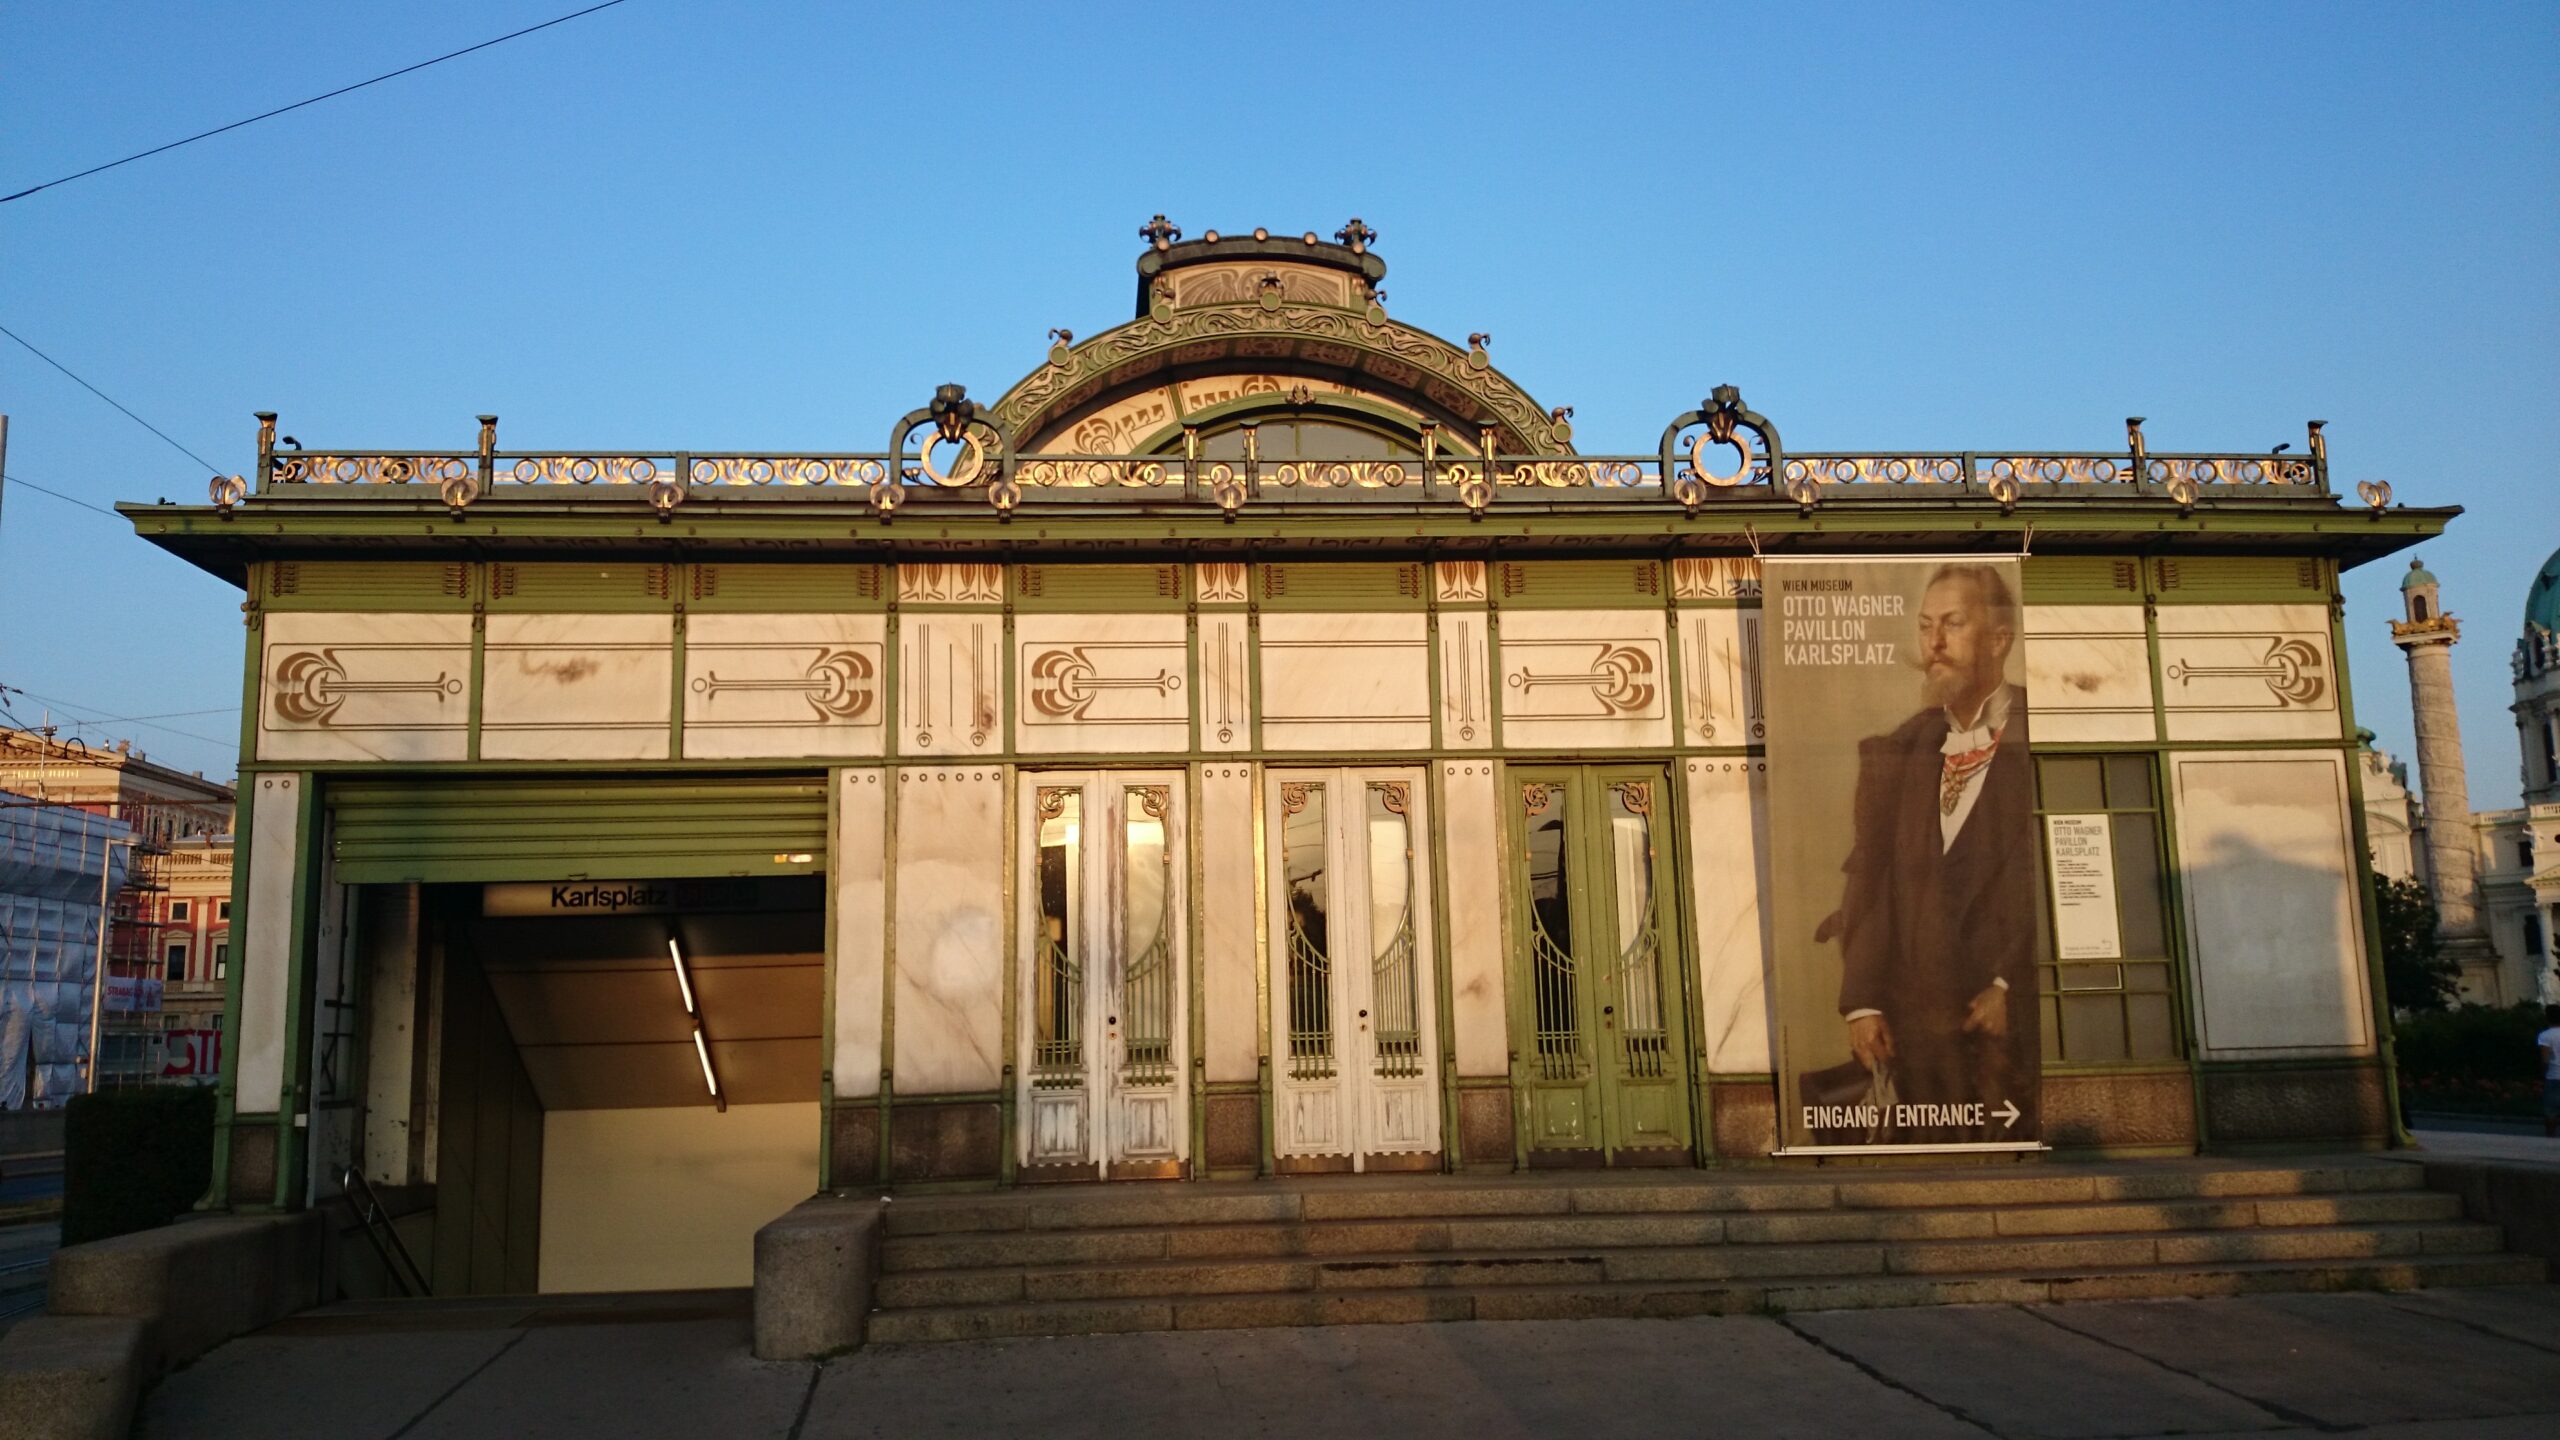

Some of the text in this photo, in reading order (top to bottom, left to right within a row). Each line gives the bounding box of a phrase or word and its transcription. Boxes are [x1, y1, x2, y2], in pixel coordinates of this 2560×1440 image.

[1782, 579, 1853, 592] WIEN MUSEUM
[1783, 595, 1905, 617] OTTO WAGNER
[1784, 619, 1866, 641] PAVILLON
[1784, 643, 1896, 665] KARLSPLATZ
[2054, 825, 2103, 836] OTTO WAGNER
[2055, 836, 2088, 847] PAVILLON
[2056, 846, 2101, 857] KARLSPLATZ
[552, 886, 668, 911] Karlsplatz
[1803, 1103, 1985, 1129] EINGANG / ENTRANCE
